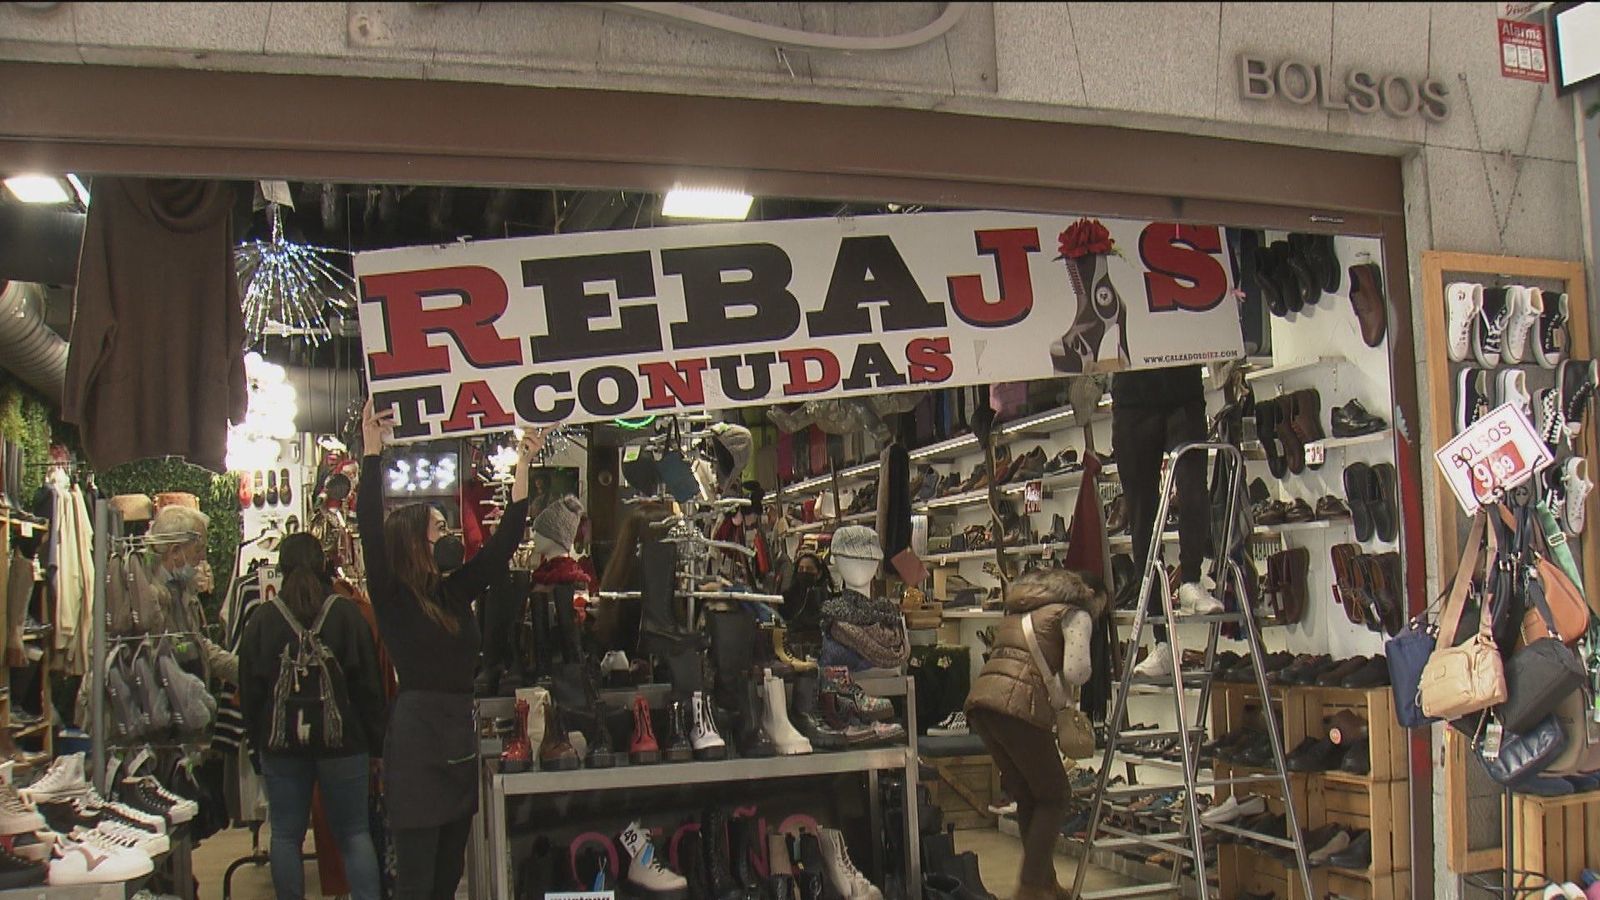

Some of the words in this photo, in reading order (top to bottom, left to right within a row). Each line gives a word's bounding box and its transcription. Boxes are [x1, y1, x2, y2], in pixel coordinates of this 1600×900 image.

[1502, 22, 1542, 41] Alarma
[1237, 53, 1451, 124] BOLSOS
[358, 222, 1228, 379] REBAJS
[373, 336, 954, 440] TACONUDAS
[1452, 420, 1512, 470] BOLSOS
